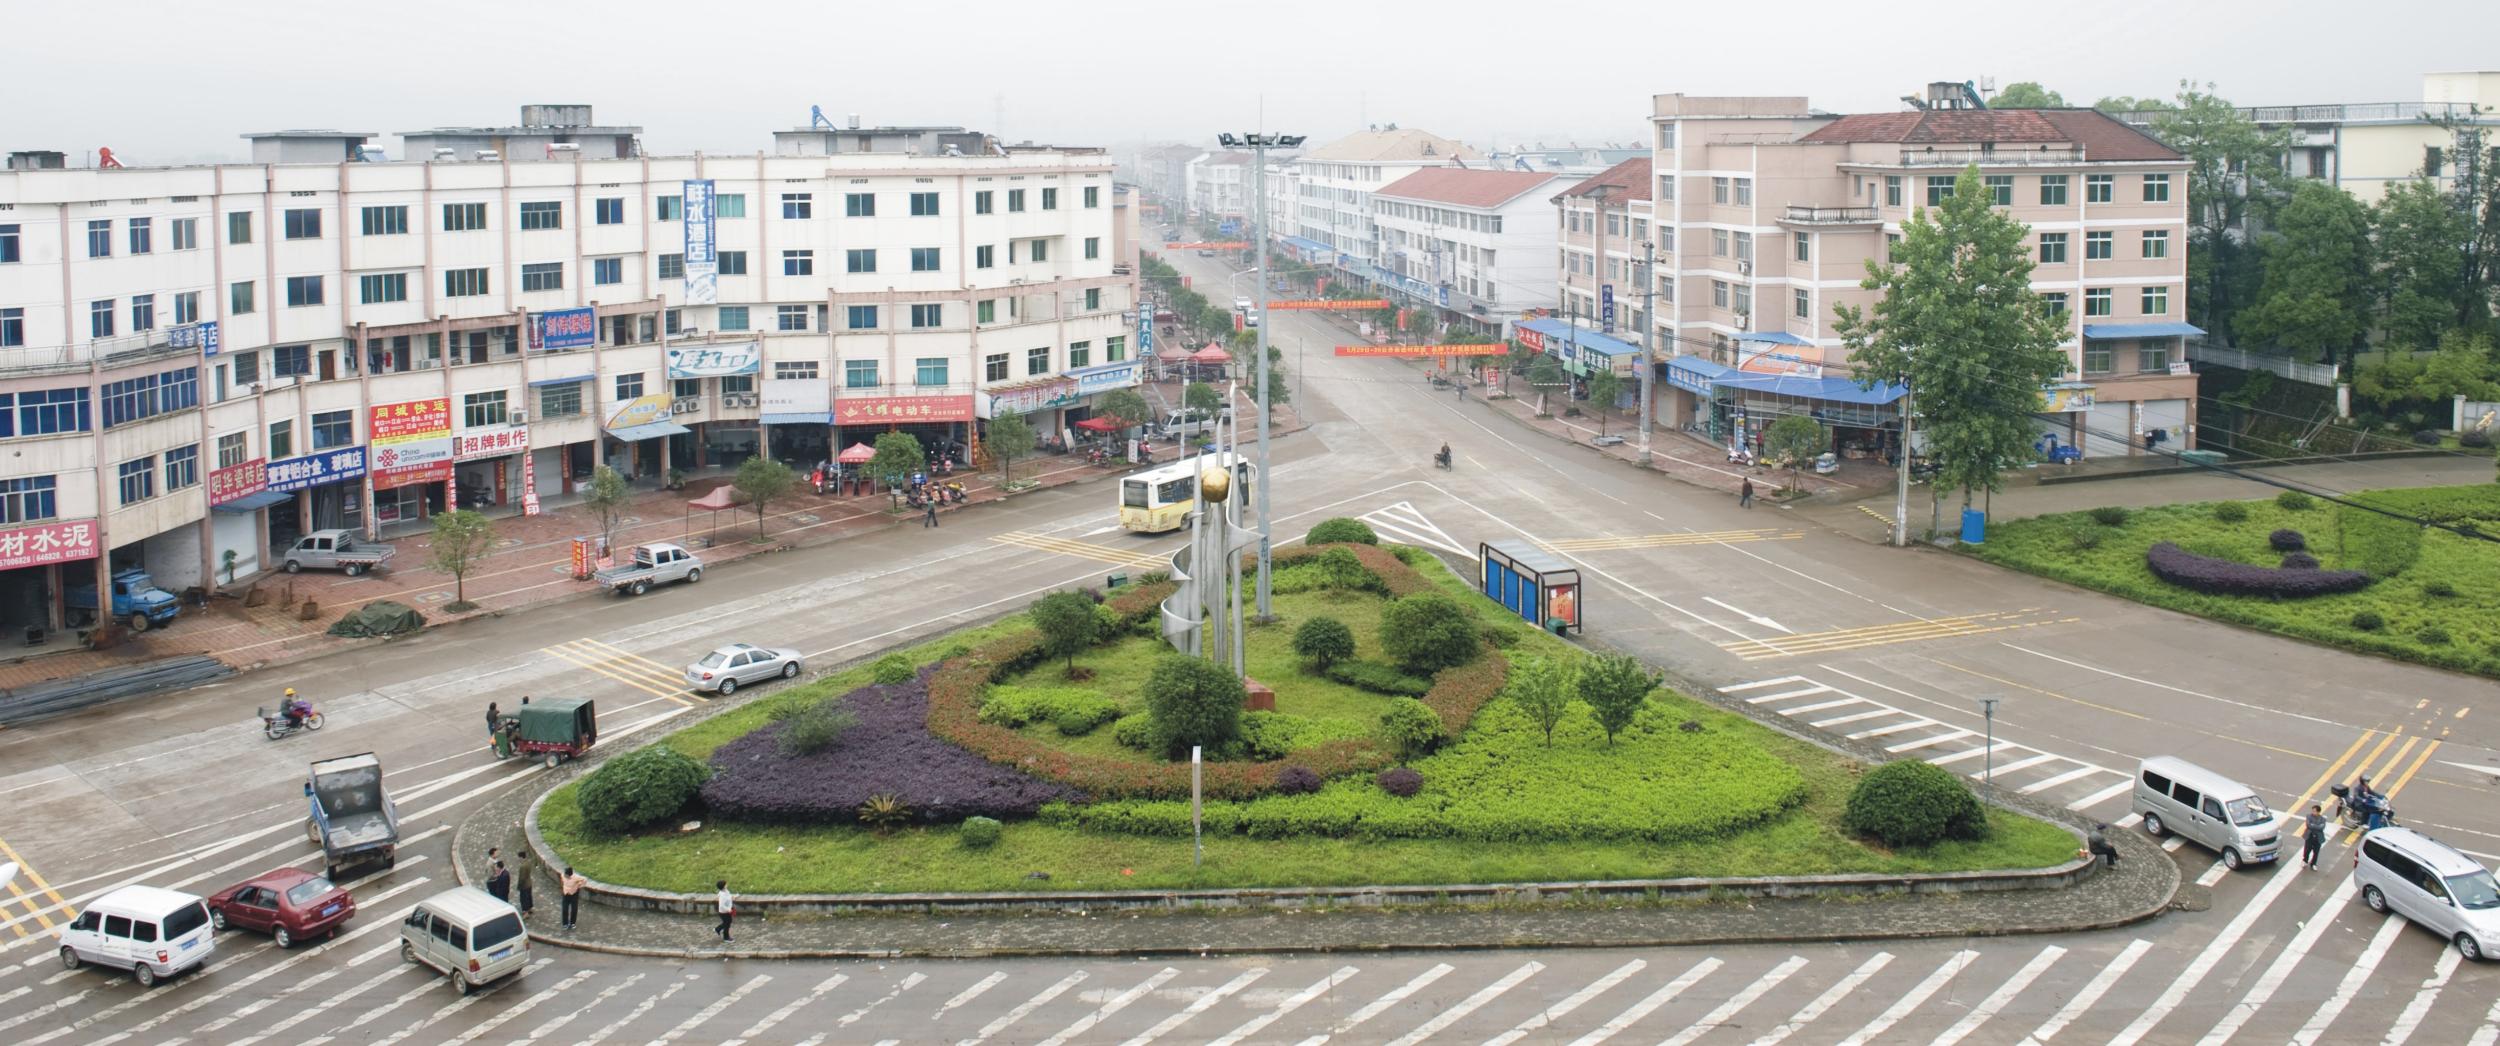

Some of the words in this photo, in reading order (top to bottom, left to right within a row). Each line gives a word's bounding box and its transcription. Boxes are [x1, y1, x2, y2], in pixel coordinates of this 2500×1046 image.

[376, 400, 447, 418] 同城快运
[464, 429, 527, 453] 招牌制作
[211, 463, 265, 495] 昭华瓷砖店
